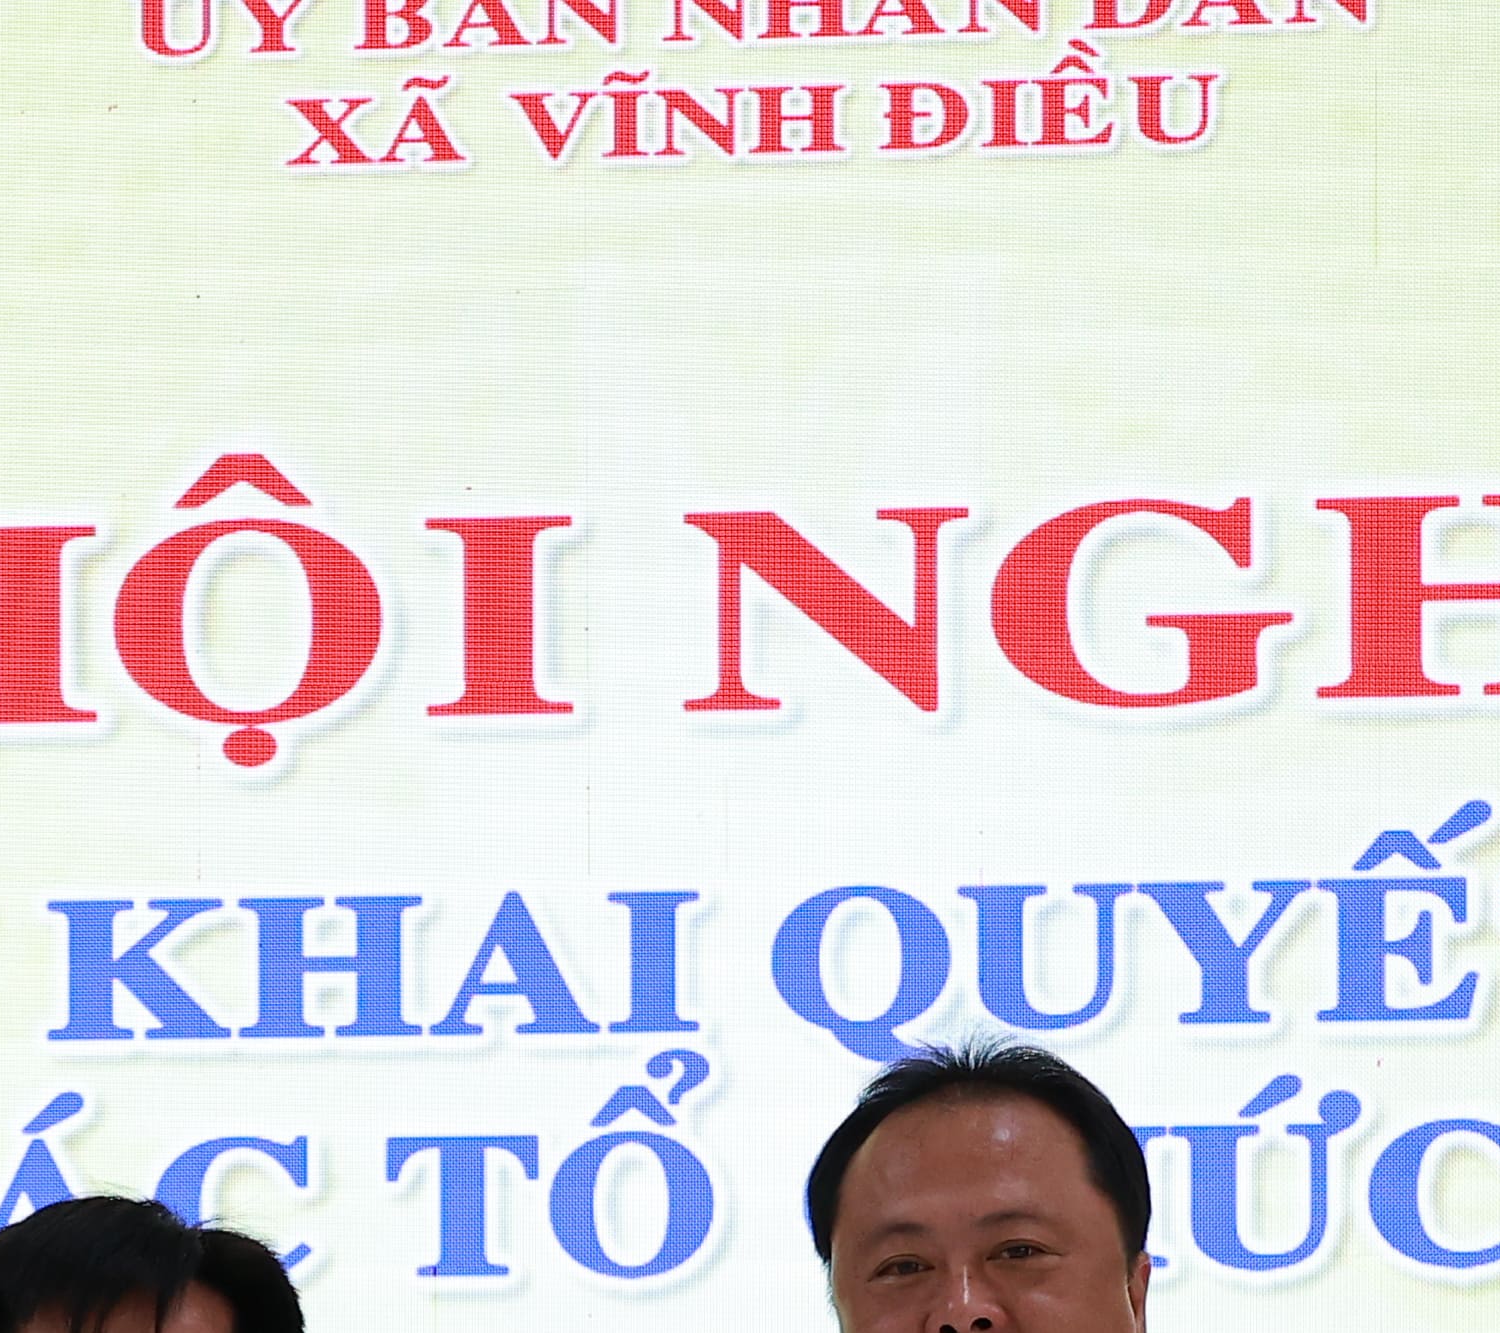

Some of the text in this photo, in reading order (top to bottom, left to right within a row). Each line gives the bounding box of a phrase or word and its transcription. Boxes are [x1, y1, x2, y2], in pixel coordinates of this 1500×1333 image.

[287, 38, 1219, 166] XÃ VĨNH ĐIỀU
[47, 890, 700, 1042] KHAI
[385, 1048, 715, 1279] TỔ
